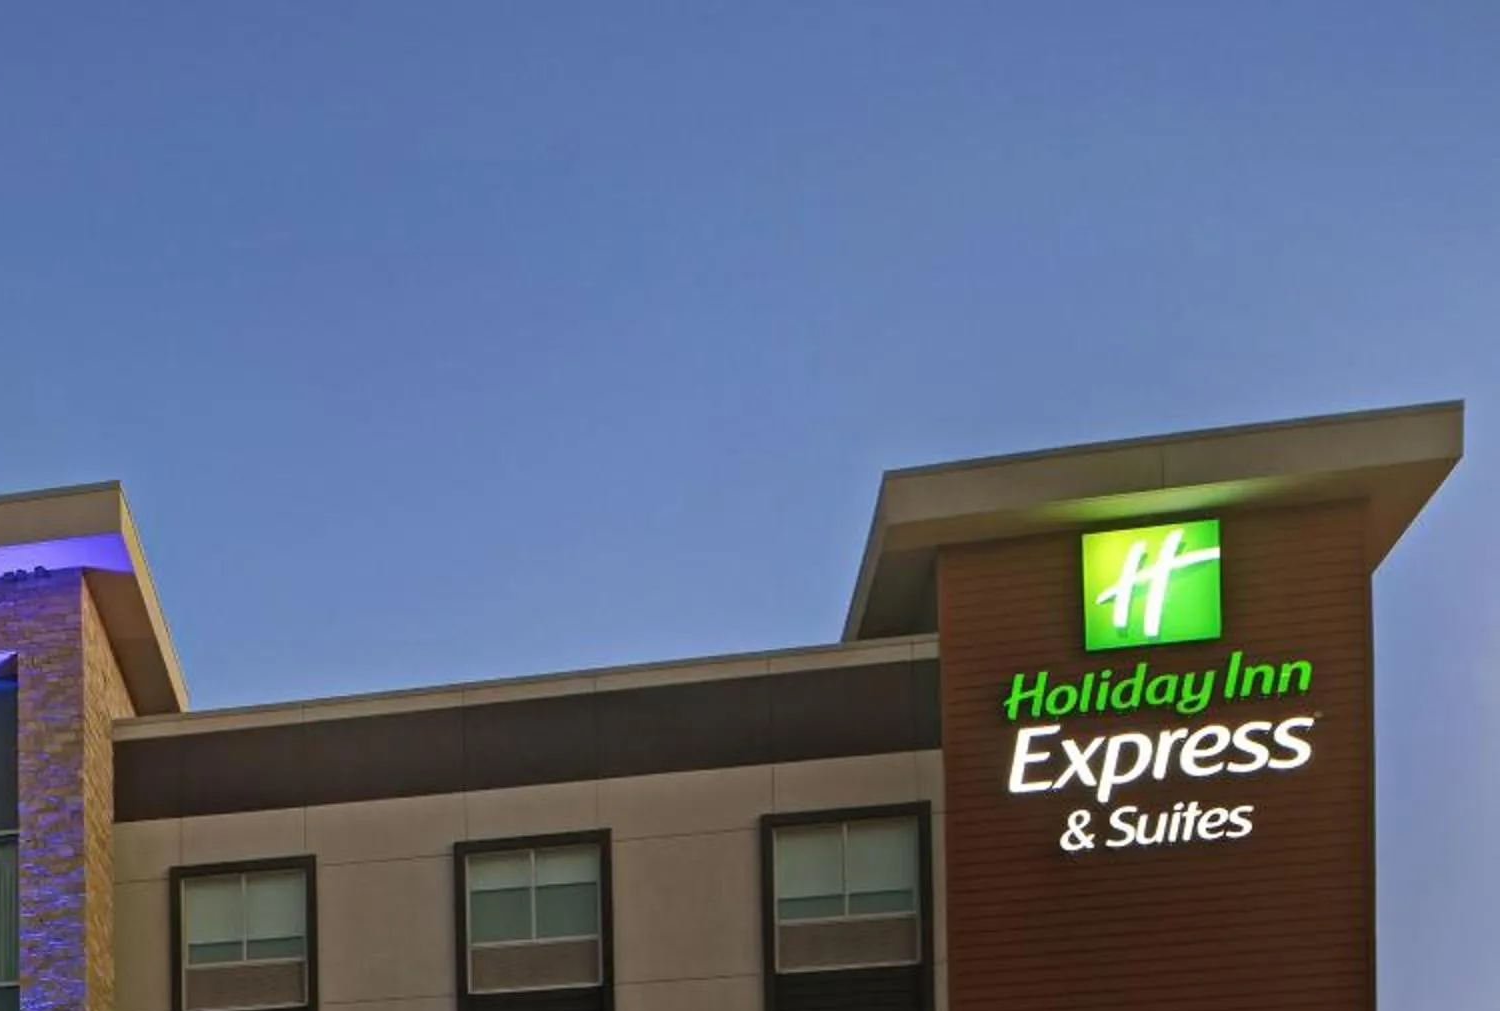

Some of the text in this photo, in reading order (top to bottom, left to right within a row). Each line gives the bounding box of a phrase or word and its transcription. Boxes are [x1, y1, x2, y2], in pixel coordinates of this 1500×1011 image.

[1004, 650, 1312, 721] Holiday Inn
[1008, 716, 1315, 803] Express
[1059, 802, 1254, 851] & Suites
